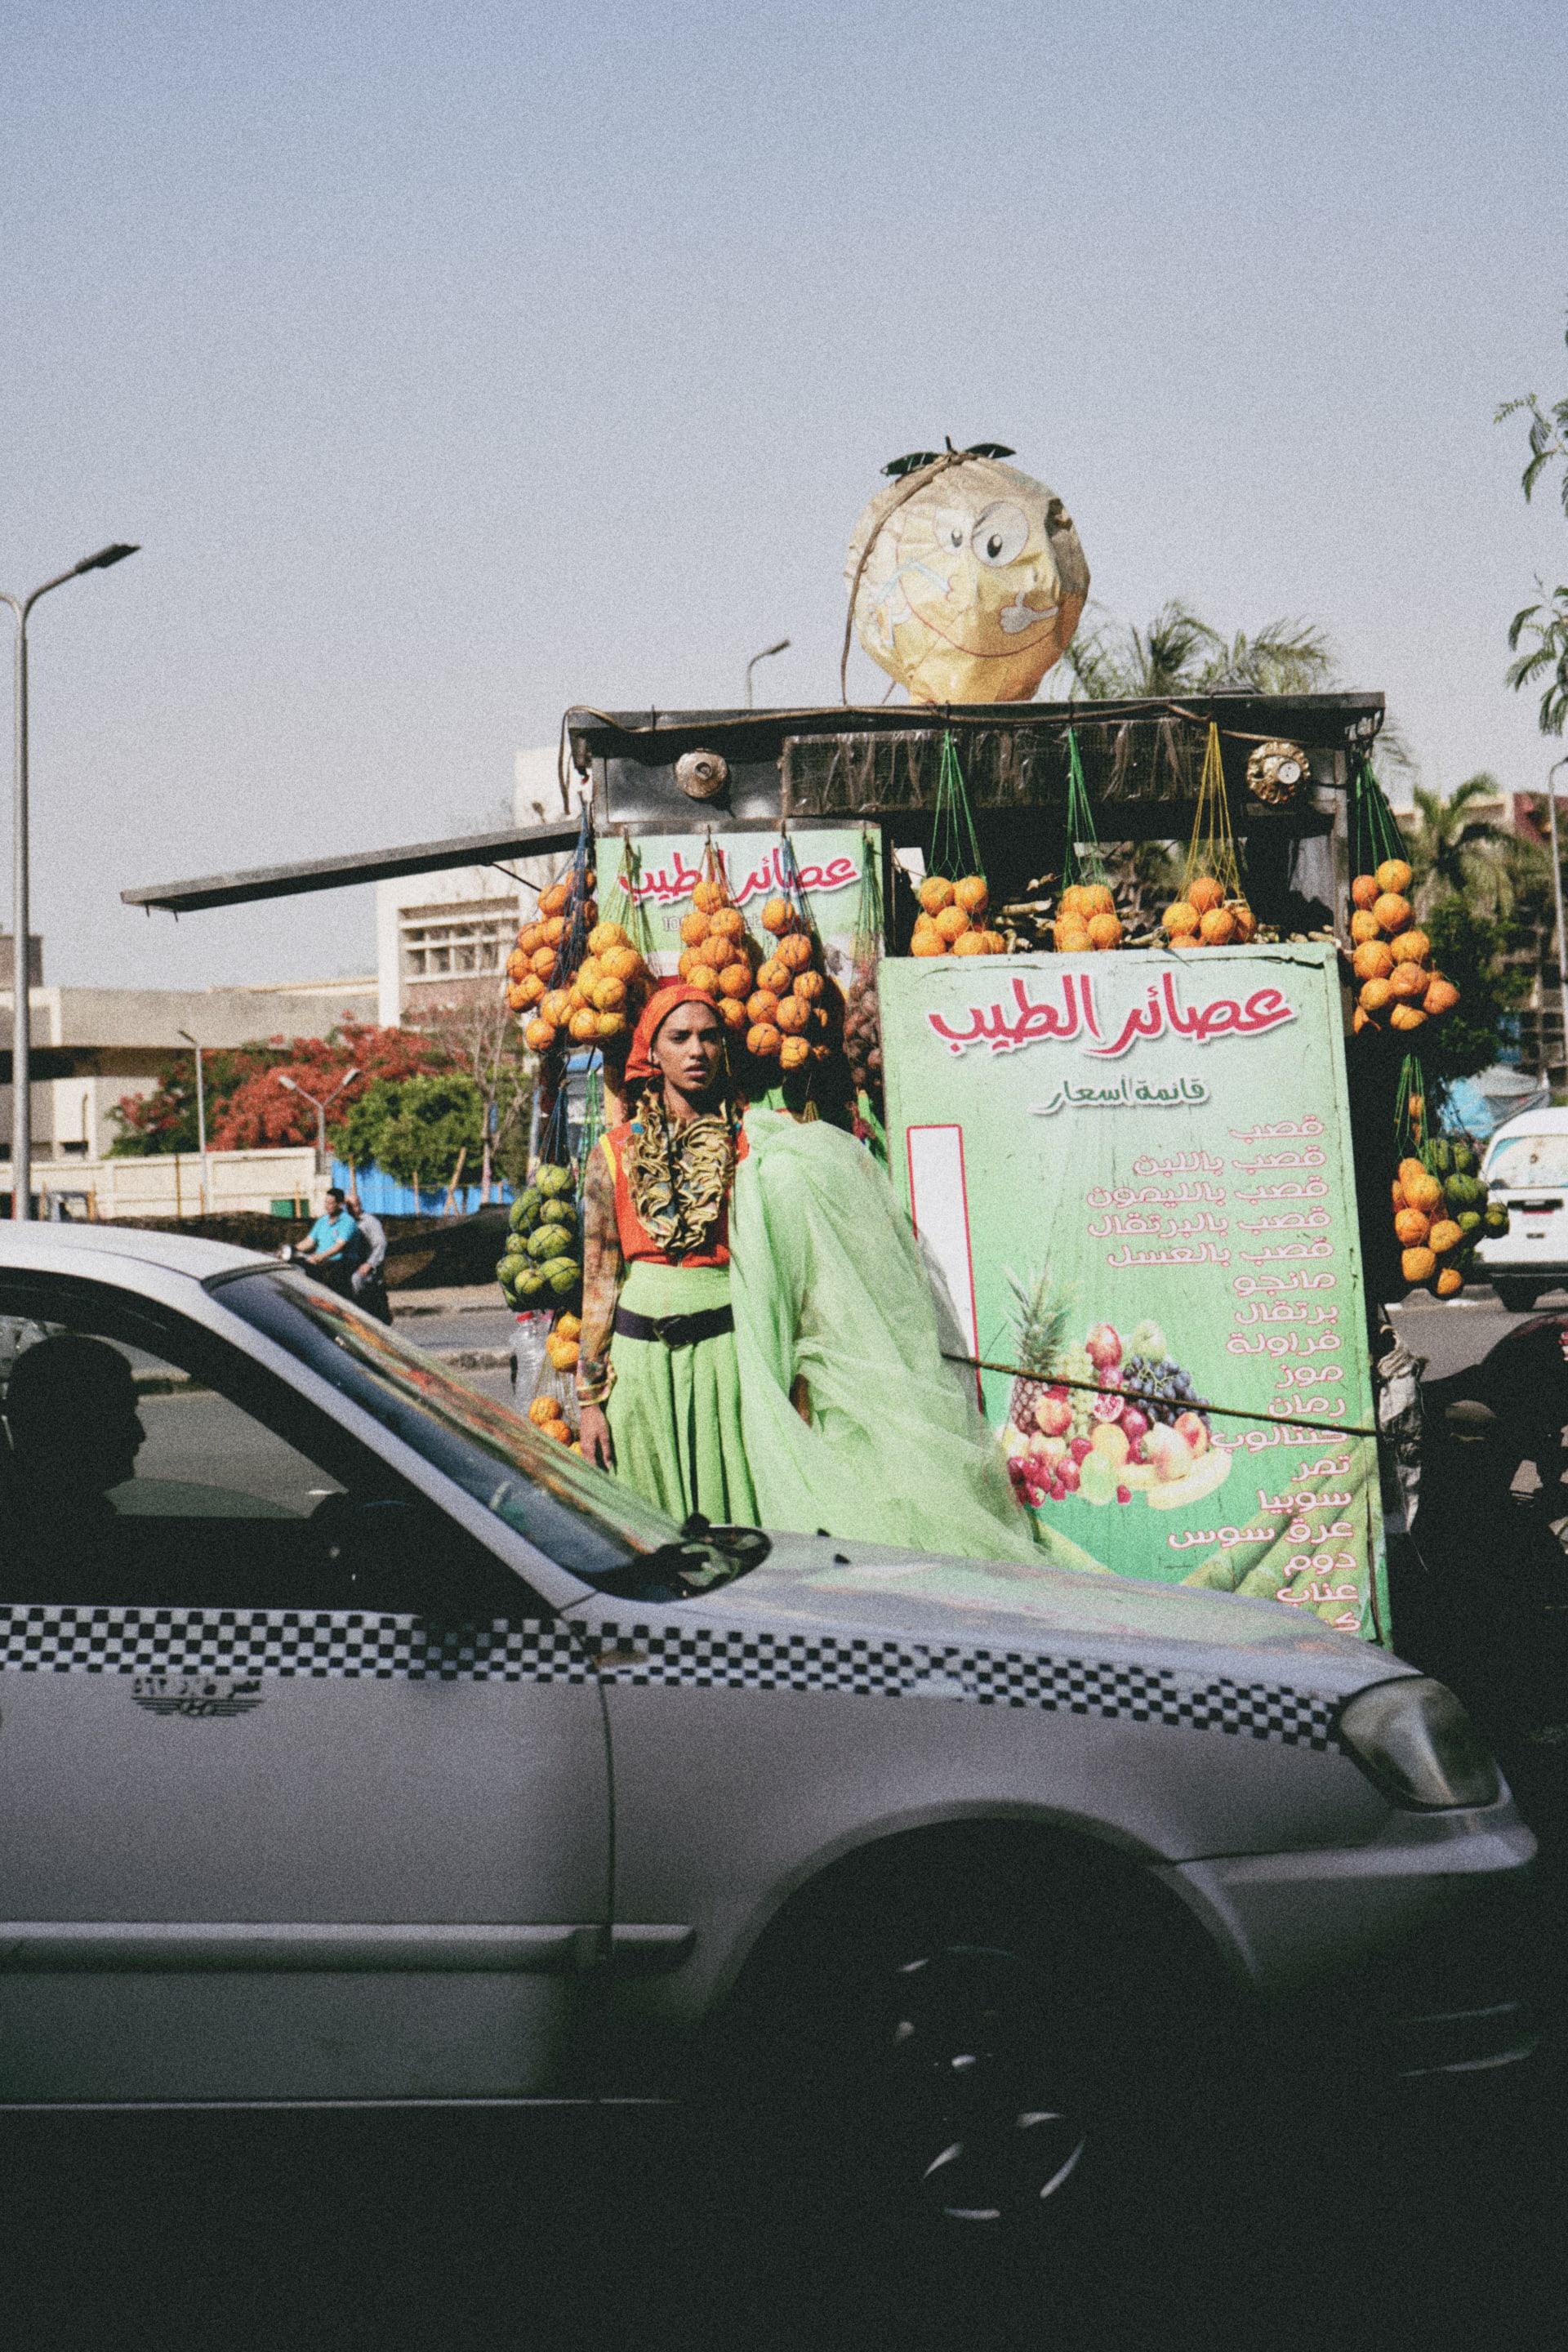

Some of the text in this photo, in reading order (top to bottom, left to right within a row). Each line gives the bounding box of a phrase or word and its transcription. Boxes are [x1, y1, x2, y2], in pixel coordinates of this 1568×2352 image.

[728, 847, 858, 904] عصائر
[928, 971, 1294, 1056] عصائر الطيب
[1134, 1076, 1206, 1102] قائمة
[1229, 1114, 1325, 1144] قصب
[1134, 1145, 1327, 1178] قصب باللبن
[1086, 1175, 1329, 1209] قصب بالليمون
[1088, 1205, 1332, 1239] قصب بالبرتقال
[1107, 1236, 1334, 1267] قصب بالعسل
[1233, 1269, 1337, 1298] مانجو
[1234, 1299, 1339, 1325] برتقال
[1227, 1328, 1342, 1358] فراولة
[1275, 1364, 1344, 1389] موز
[1267, 1392, 1347, 1419] رمان
[1290, 1454, 1351, 1482] تمر
[1256, 1489, 1352, 1516] سوبيا
[1168, 1517, 1354, 1550] عرق سوس
[1283, 1551, 1357, 1578] دوم
[1276, 1581, 1359, 1608] عناب
